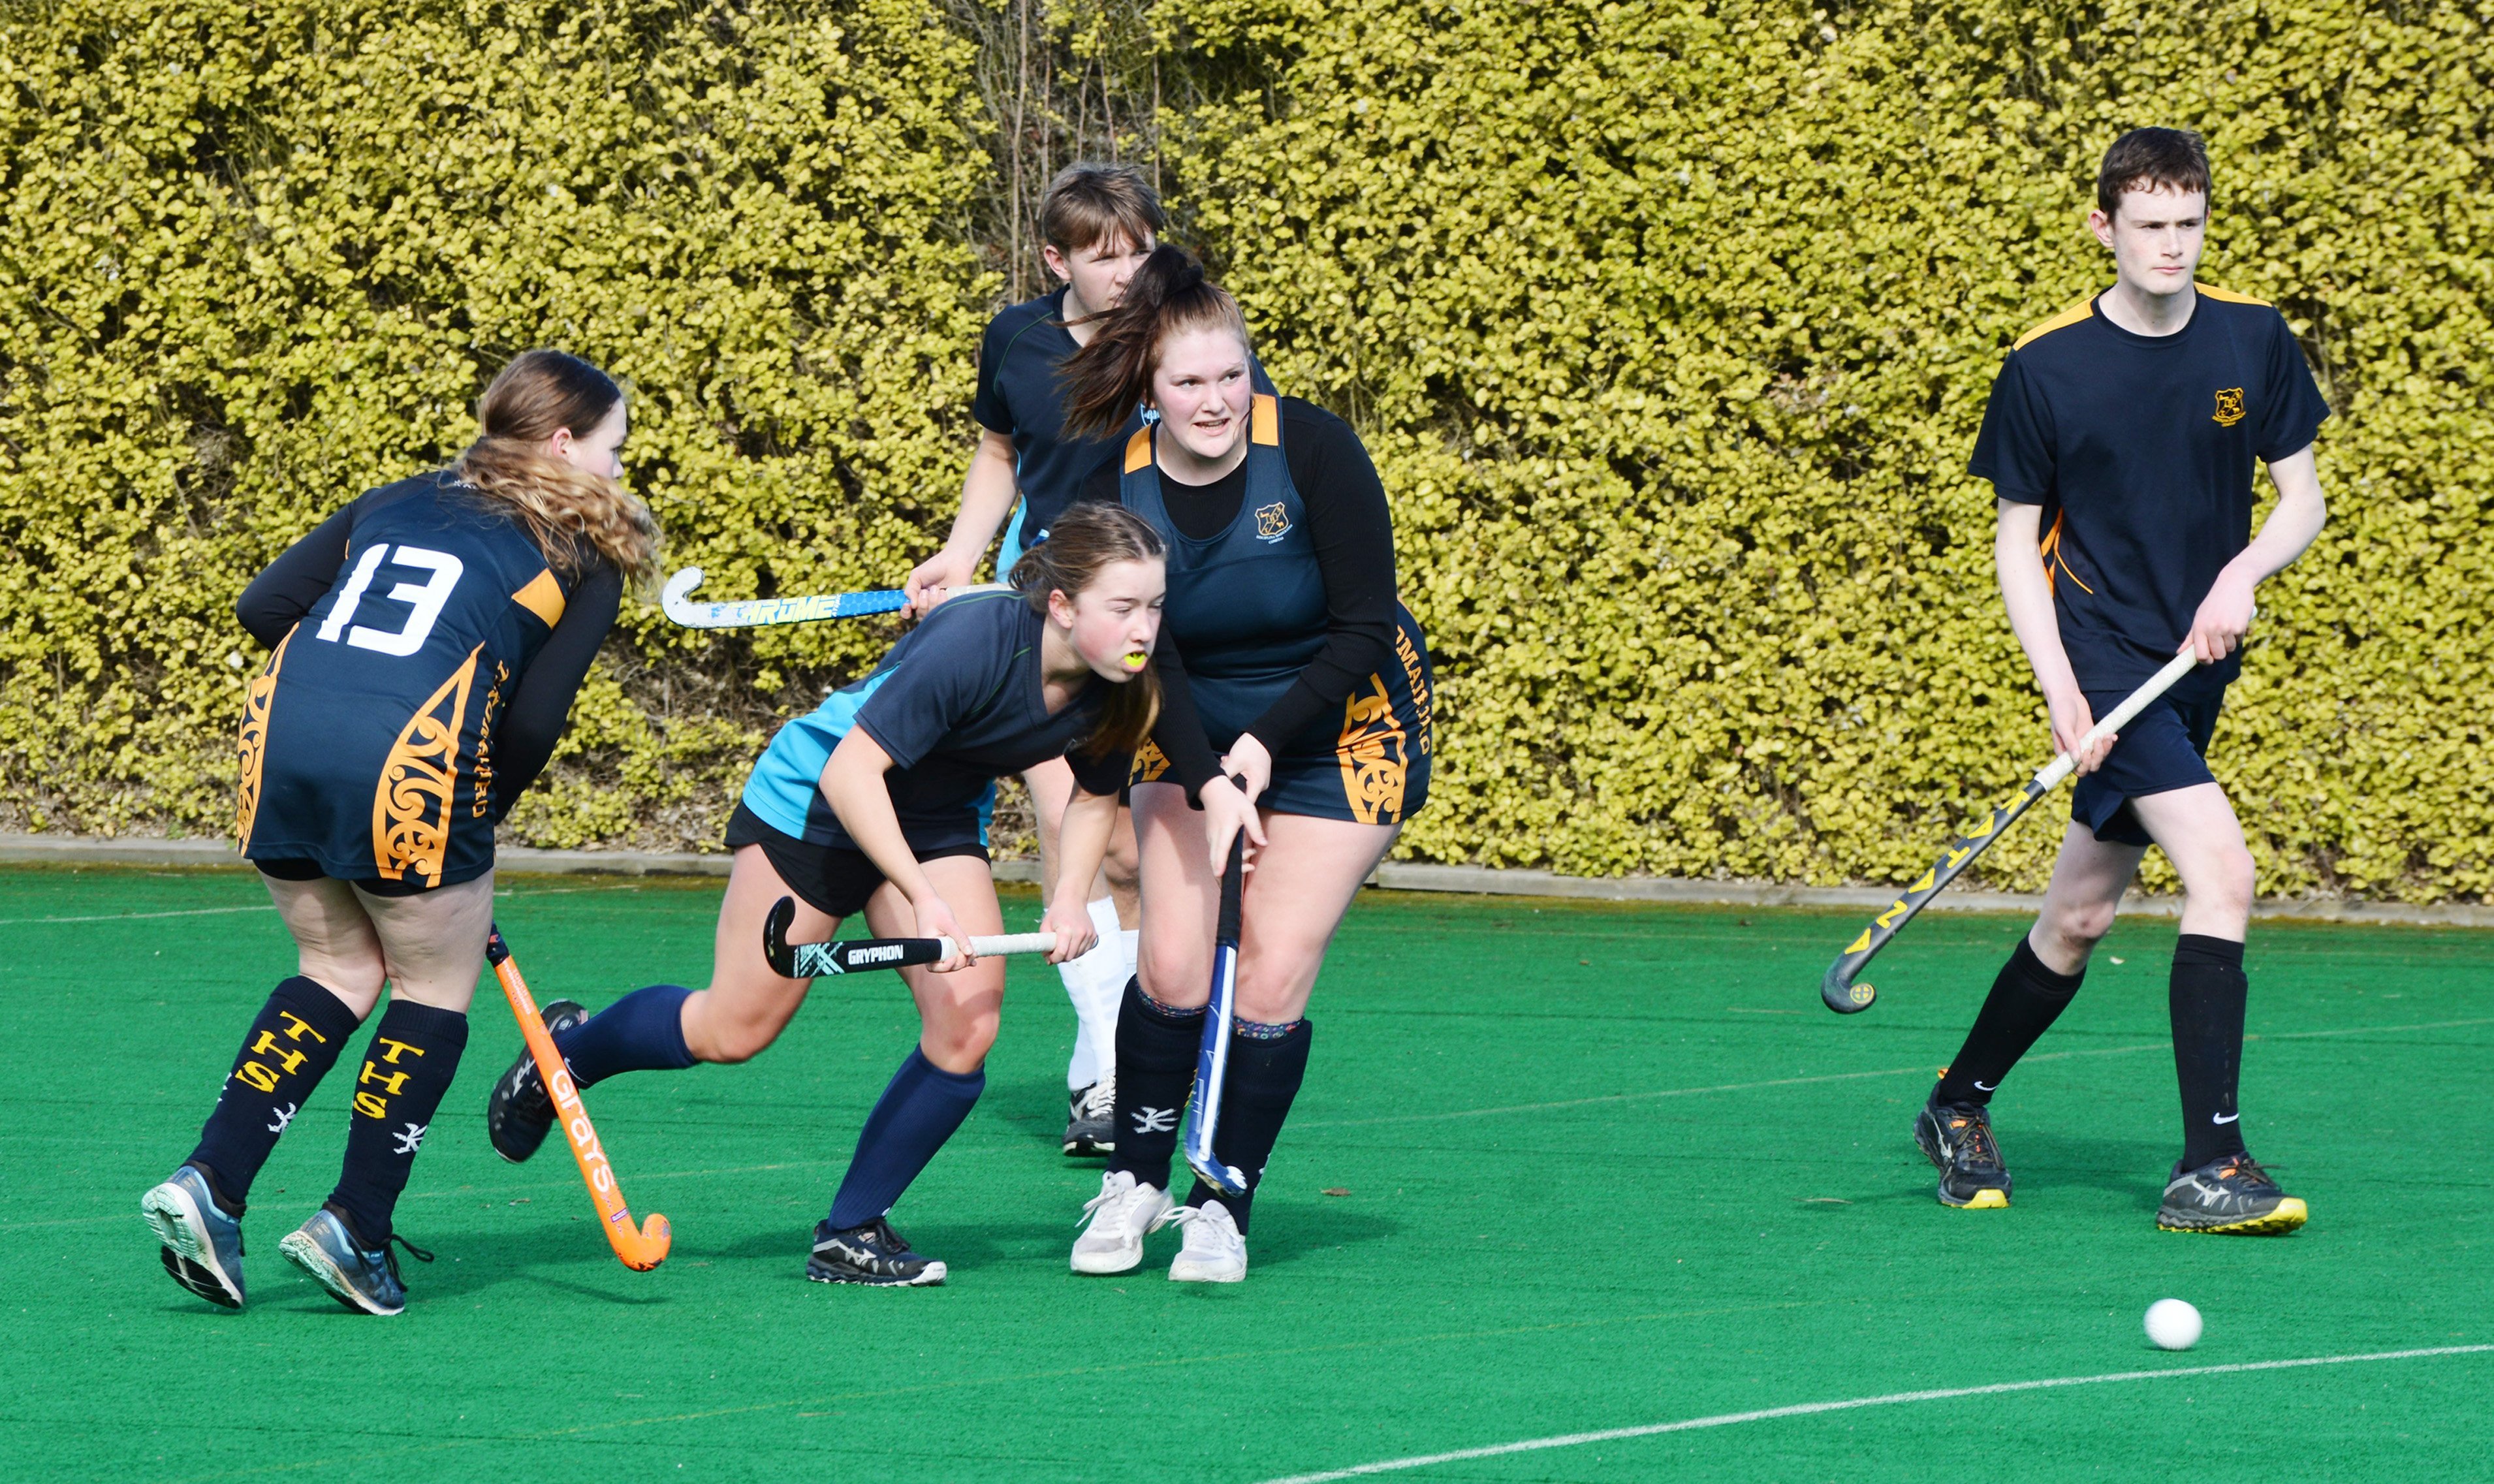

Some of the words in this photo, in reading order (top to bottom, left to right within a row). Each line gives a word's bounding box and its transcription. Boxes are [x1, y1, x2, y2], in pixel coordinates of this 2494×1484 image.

[316, 543, 464, 657] 13
[1844, 791, 2031, 955] KATANA
[848, 944, 904, 965] GRYPHON
[236, 1011, 326, 1094] THS
[353, 1037, 425, 1120] THS
